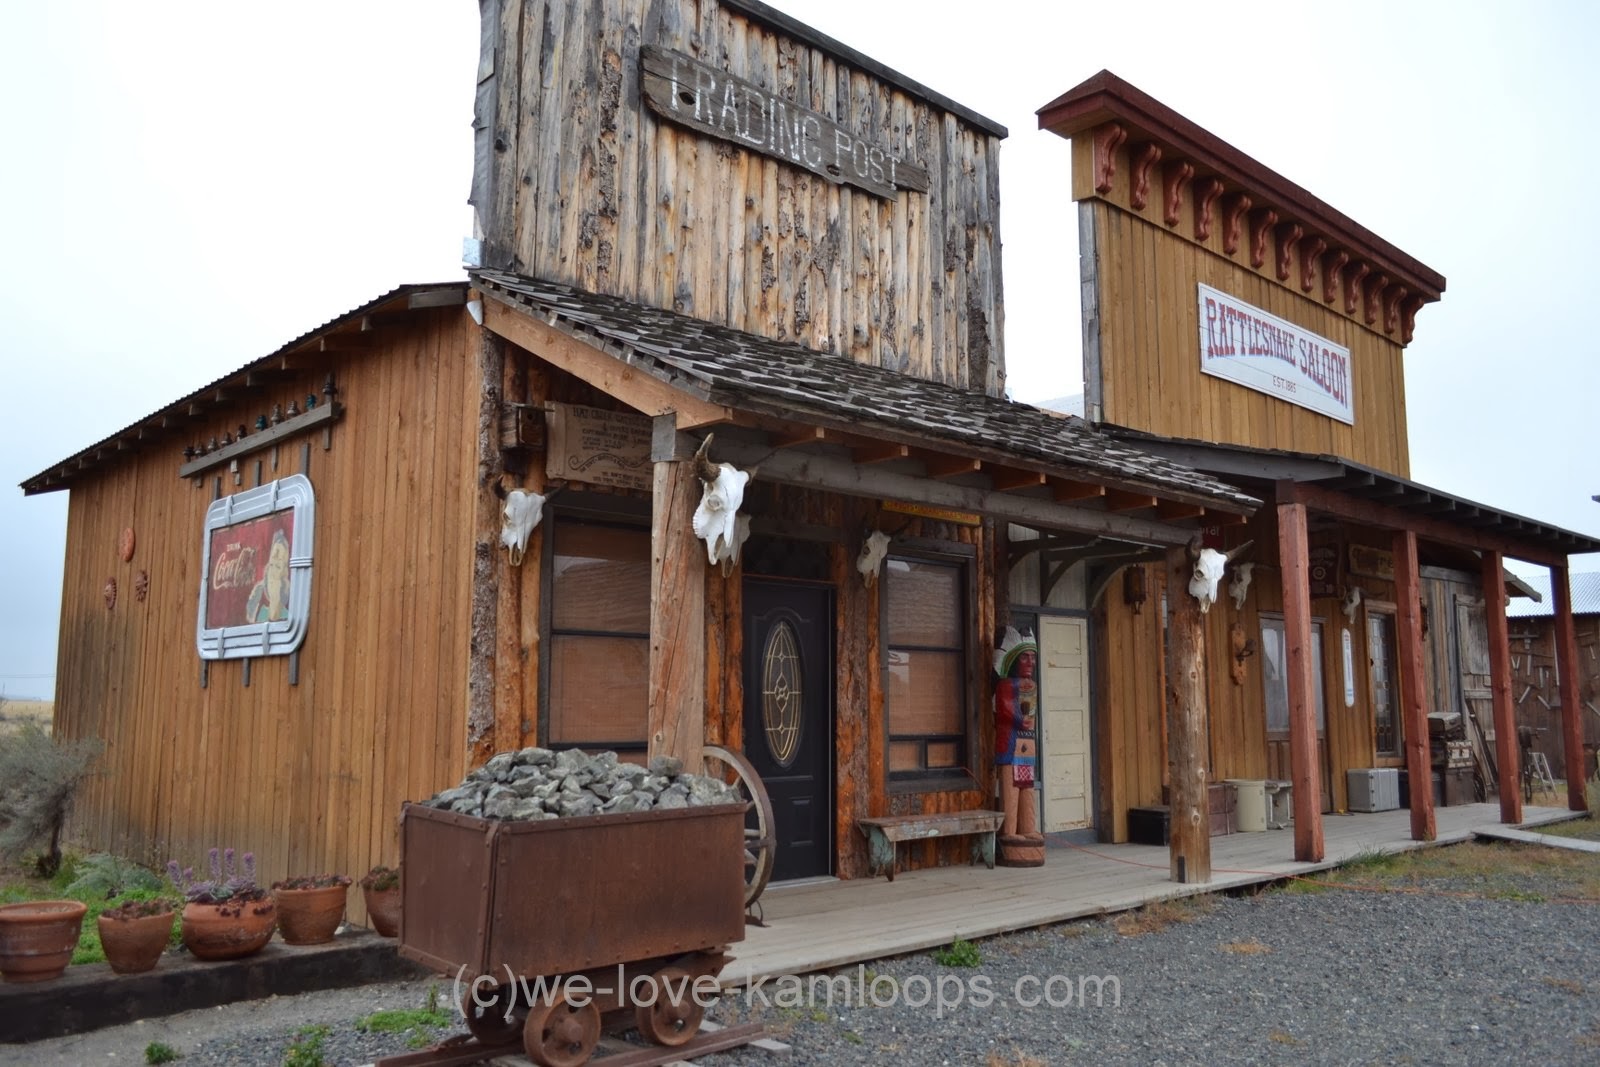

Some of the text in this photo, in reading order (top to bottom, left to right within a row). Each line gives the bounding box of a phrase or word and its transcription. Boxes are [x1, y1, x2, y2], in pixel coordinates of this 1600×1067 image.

[662, 52, 900, 191] TRADING POST
[1205, 296, 1348, 410] RATTLESNAKE SALOON
